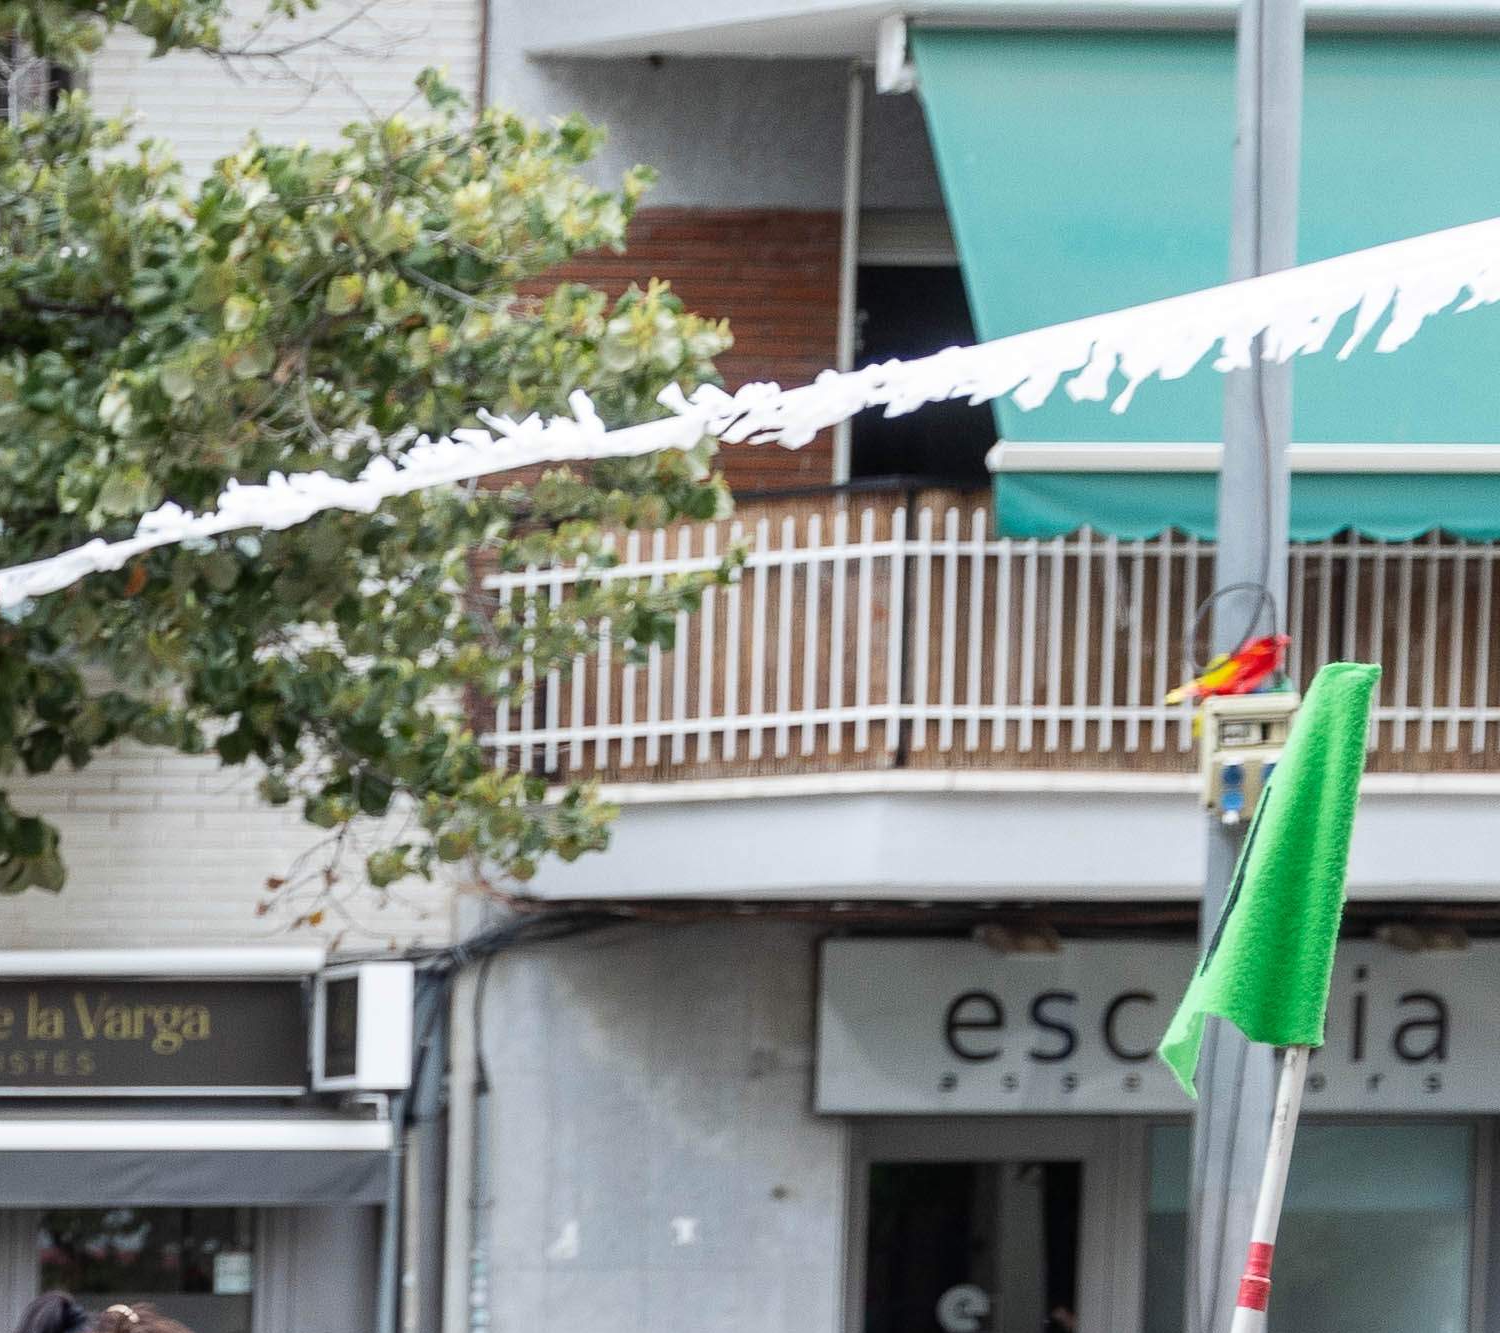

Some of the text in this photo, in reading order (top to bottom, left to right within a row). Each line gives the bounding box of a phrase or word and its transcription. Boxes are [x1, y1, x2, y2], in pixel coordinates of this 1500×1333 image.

[27, 991, 65, 1041] la
[73, 991, 210, 1055] Varga
[945, 964, 1451, 1064] escia
[937, 1071, 1442, 1093] asseors
